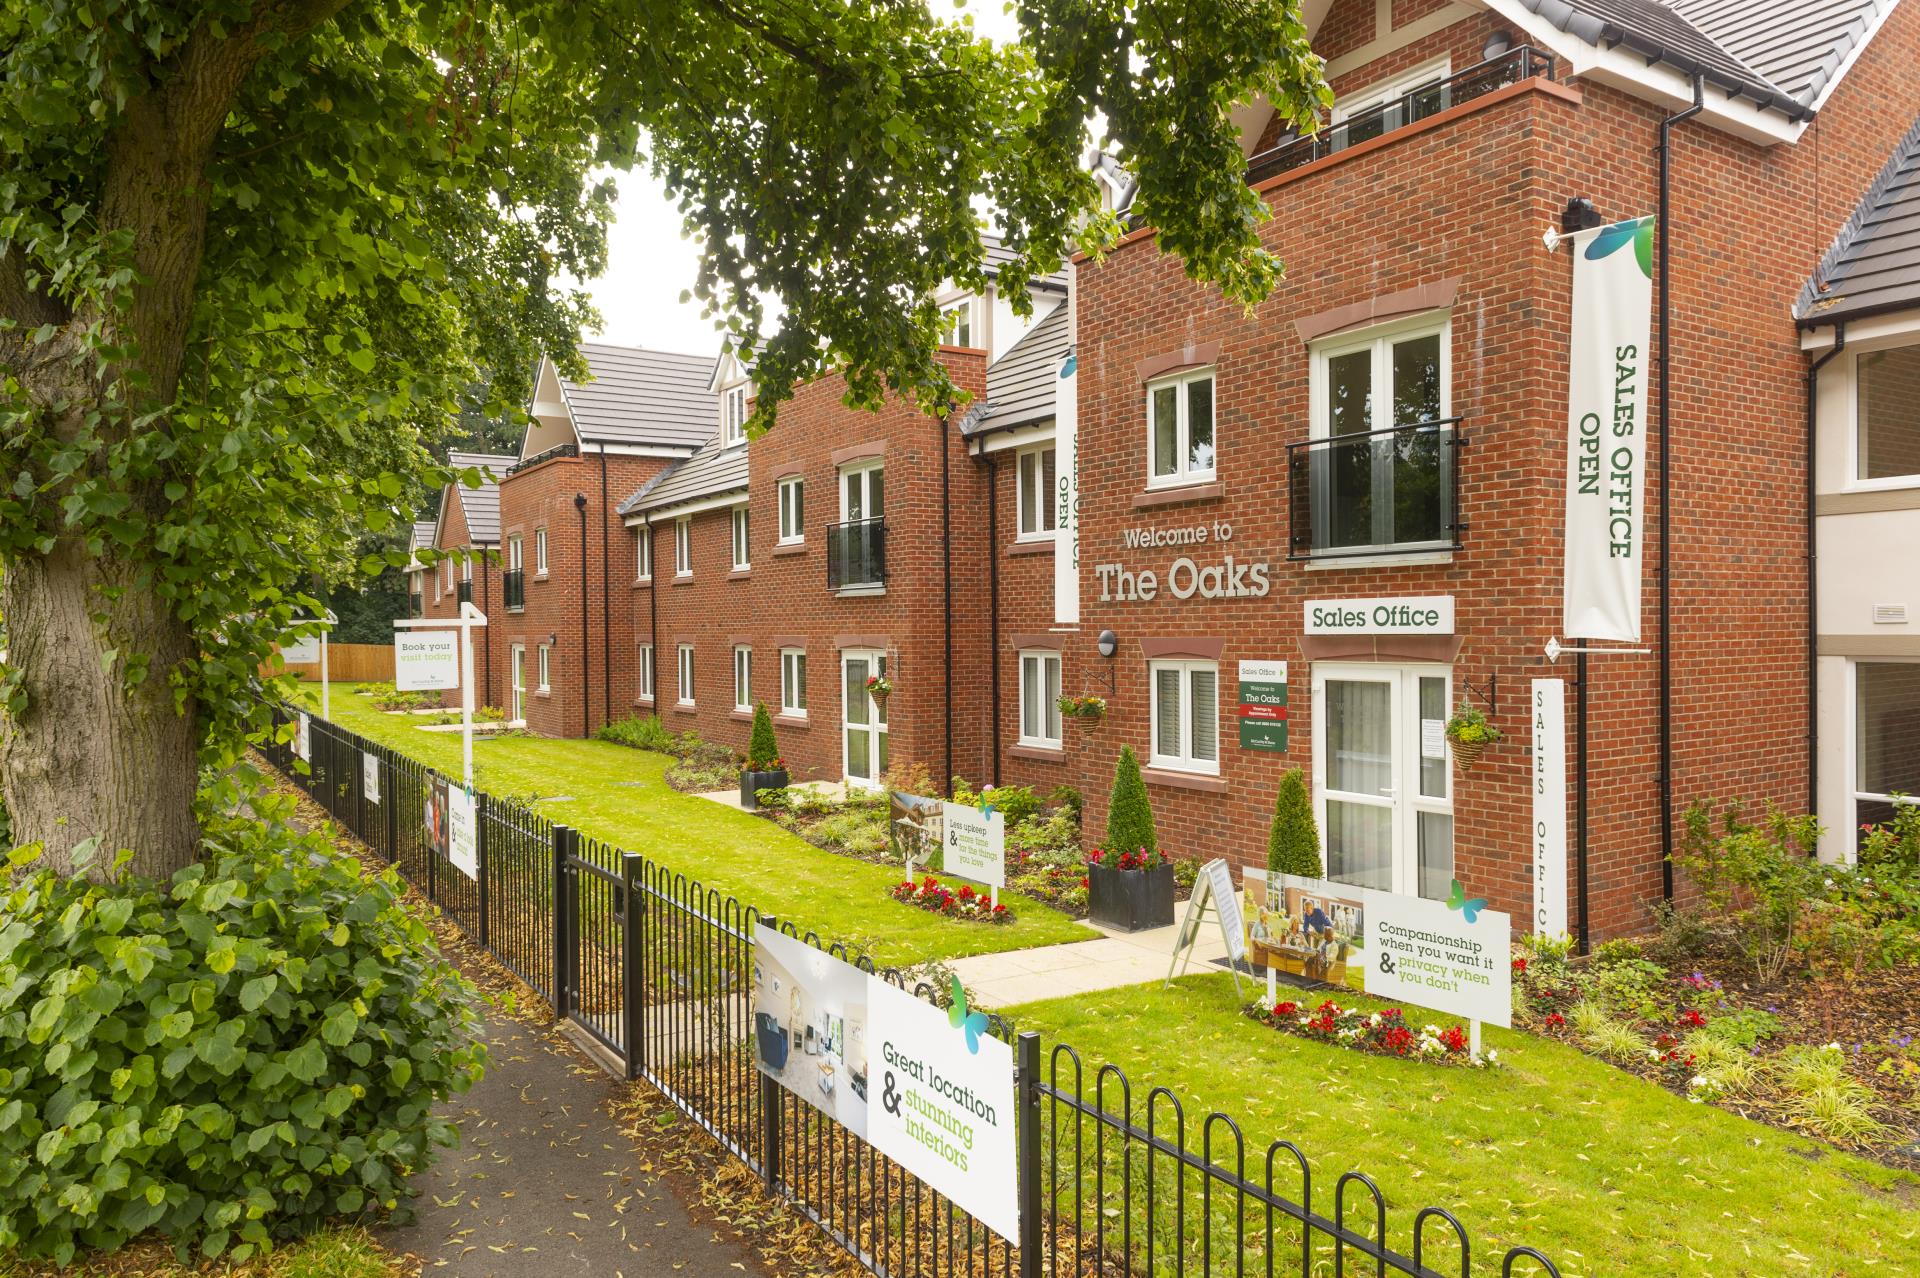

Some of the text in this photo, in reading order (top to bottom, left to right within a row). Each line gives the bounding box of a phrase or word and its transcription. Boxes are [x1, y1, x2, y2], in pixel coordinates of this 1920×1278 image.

[1578, 412, 1600, 496] OPEN
[1610, 344, 1637, 559] SALES OFFICE
[1059, 476, 1069, 530] OPEN
[1124, 521, 1232, 549] Welcome to
[1096, 555, 1270, 602] The Oaks
[1313, 605, 1439, 628] Sales Office
[400, 653, 452, 662] visit today
[401, 643, 450, 652] Book your
[1242, 667, 1275, 676] Sales Office
[1245, 693, 1280, 704] The Oaks
[1536, 690, 1545, 795] SALES
[950, 819, 987, 837] Less upkeep
[950, 830, 958, 847] &
[978, 847, 998, 862] things
[1379, 921, 1482, 954] Companionship
[1379, 937, 1494, 970] when you want it
[1379, 952, 1490, 985] & privacy when
[1398, 970, 1459, 992] you don't
[882, 1041, 998, 1127] Great location
[882, 1070, 974, 1150] & stunning
[905, 1112, 968, 1173] interiors
